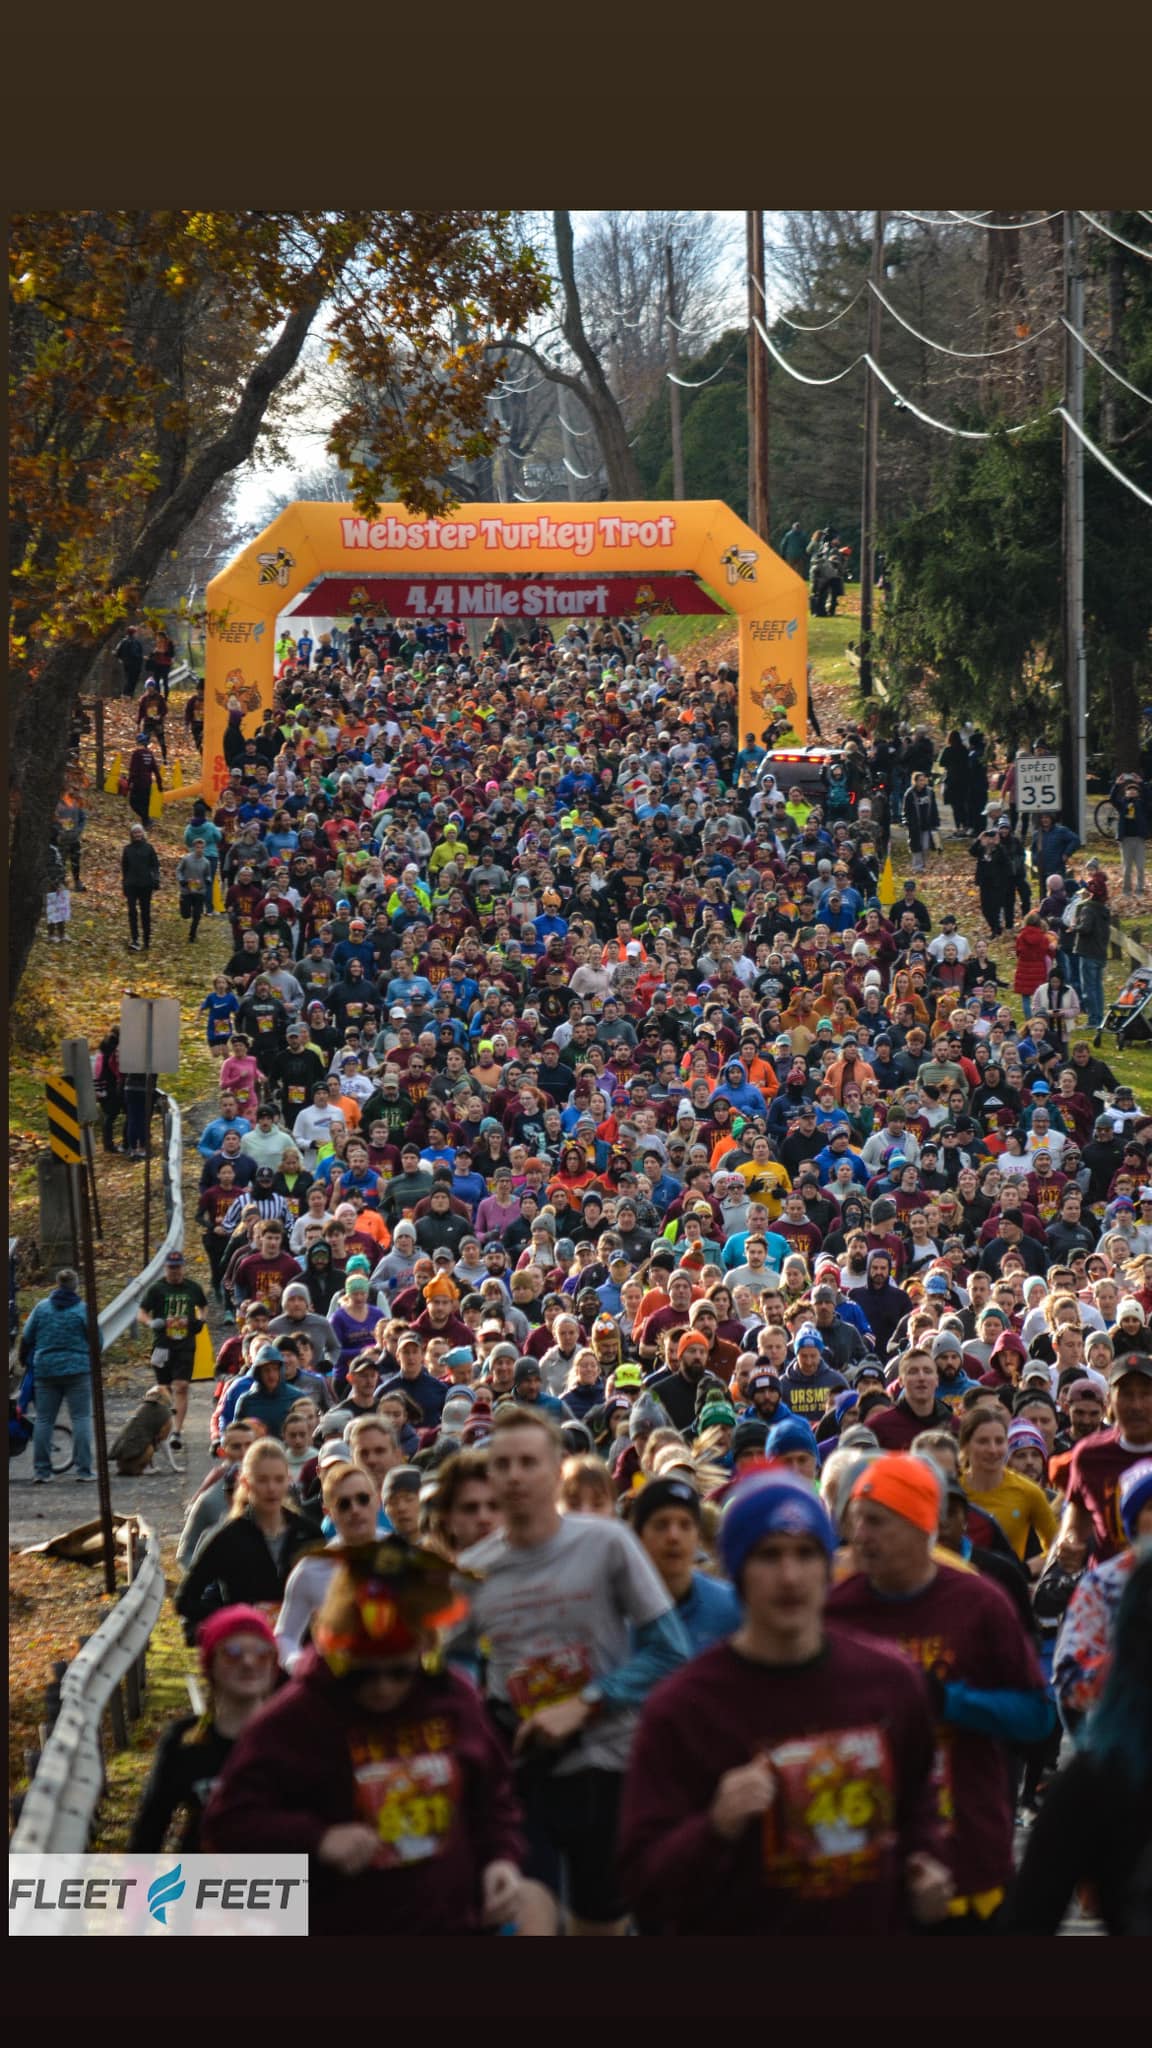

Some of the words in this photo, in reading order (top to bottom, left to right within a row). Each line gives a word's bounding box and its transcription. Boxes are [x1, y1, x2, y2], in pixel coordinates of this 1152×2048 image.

[341, 516, 477, 550] Webster
[480, 516, 596, 556] Turkey
[598, 516, 675, 547] Trot
[405, 586, 453, 615] 4.4
[457, 582, 520, 615] Mile
[522, 585, 608, 615] Start
[223, 622, 256, 633] LEET
[749, 620, 787, 632] FLEET
[219, 632, 251, 643] FEET
[752, 631, 784, 641] FEET
[1020, 763, 1056, 773] SPEED
[1023, 774, 1052, 784] LIMIT
[1022, 785, 1056, 805] 35
